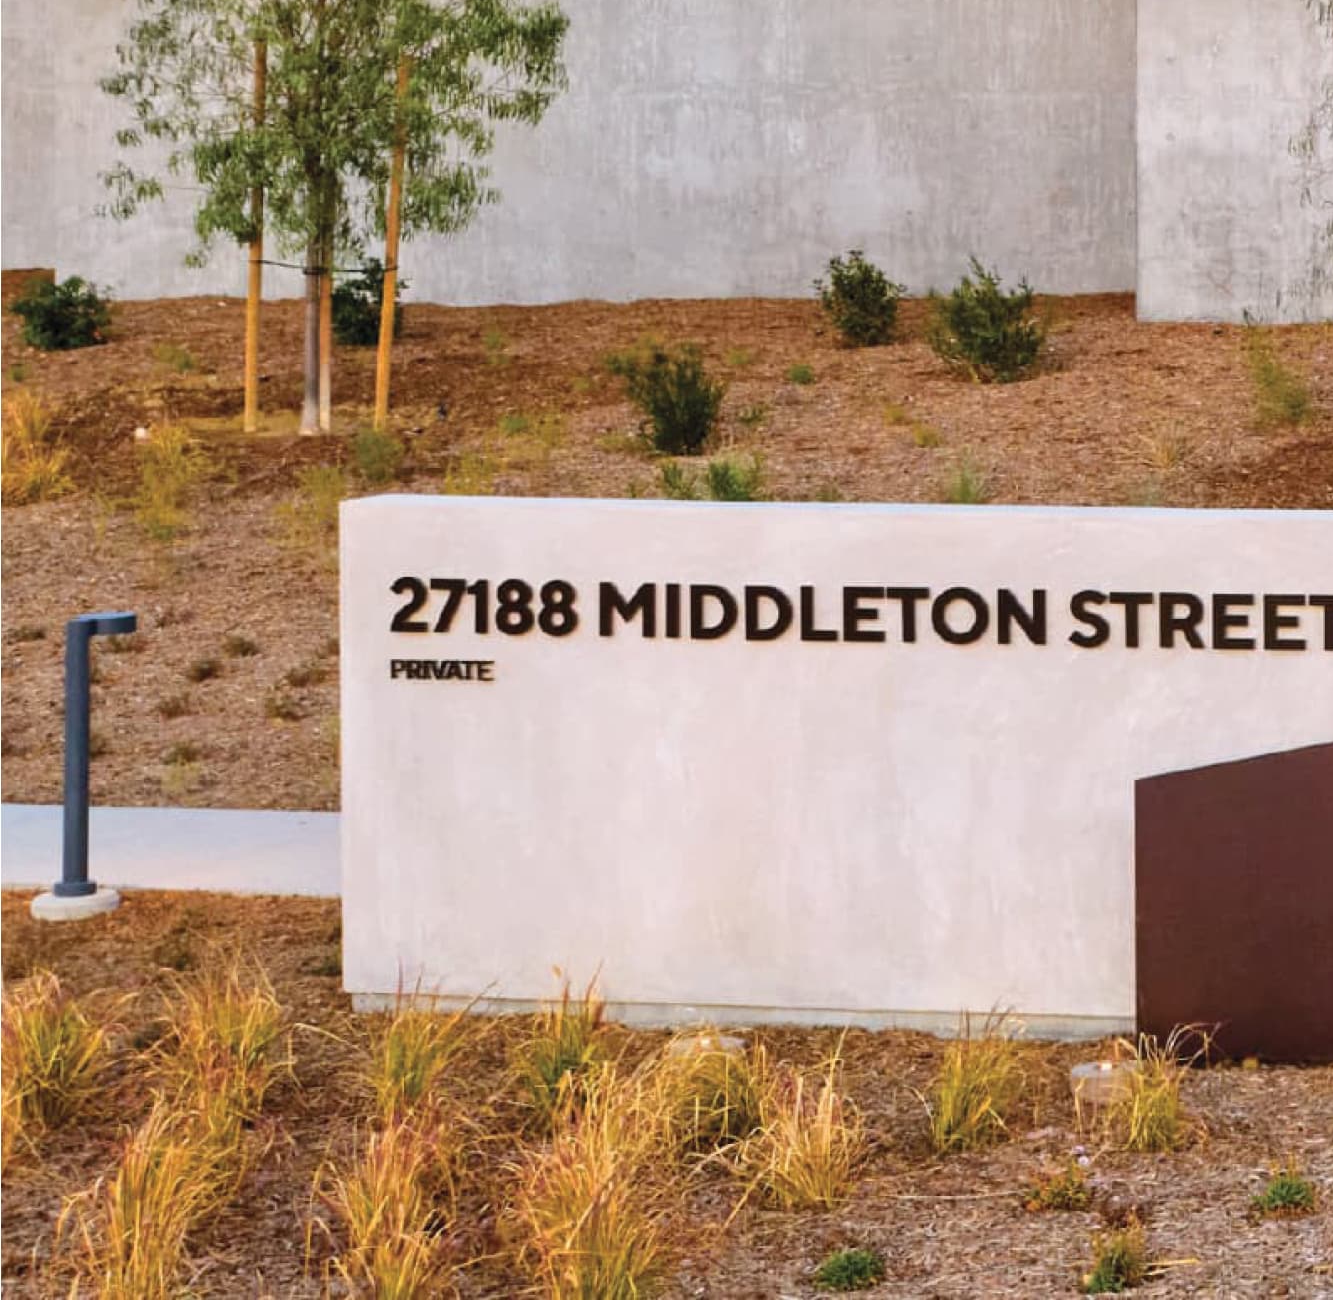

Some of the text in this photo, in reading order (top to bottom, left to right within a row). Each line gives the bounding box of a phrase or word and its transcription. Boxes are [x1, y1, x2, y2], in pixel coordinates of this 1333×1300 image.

[390, 576, 579, 637] 27188
[599, 581, 1047, 645] MIDDLETON
[390, 659, 496, 682] PRIVATE
